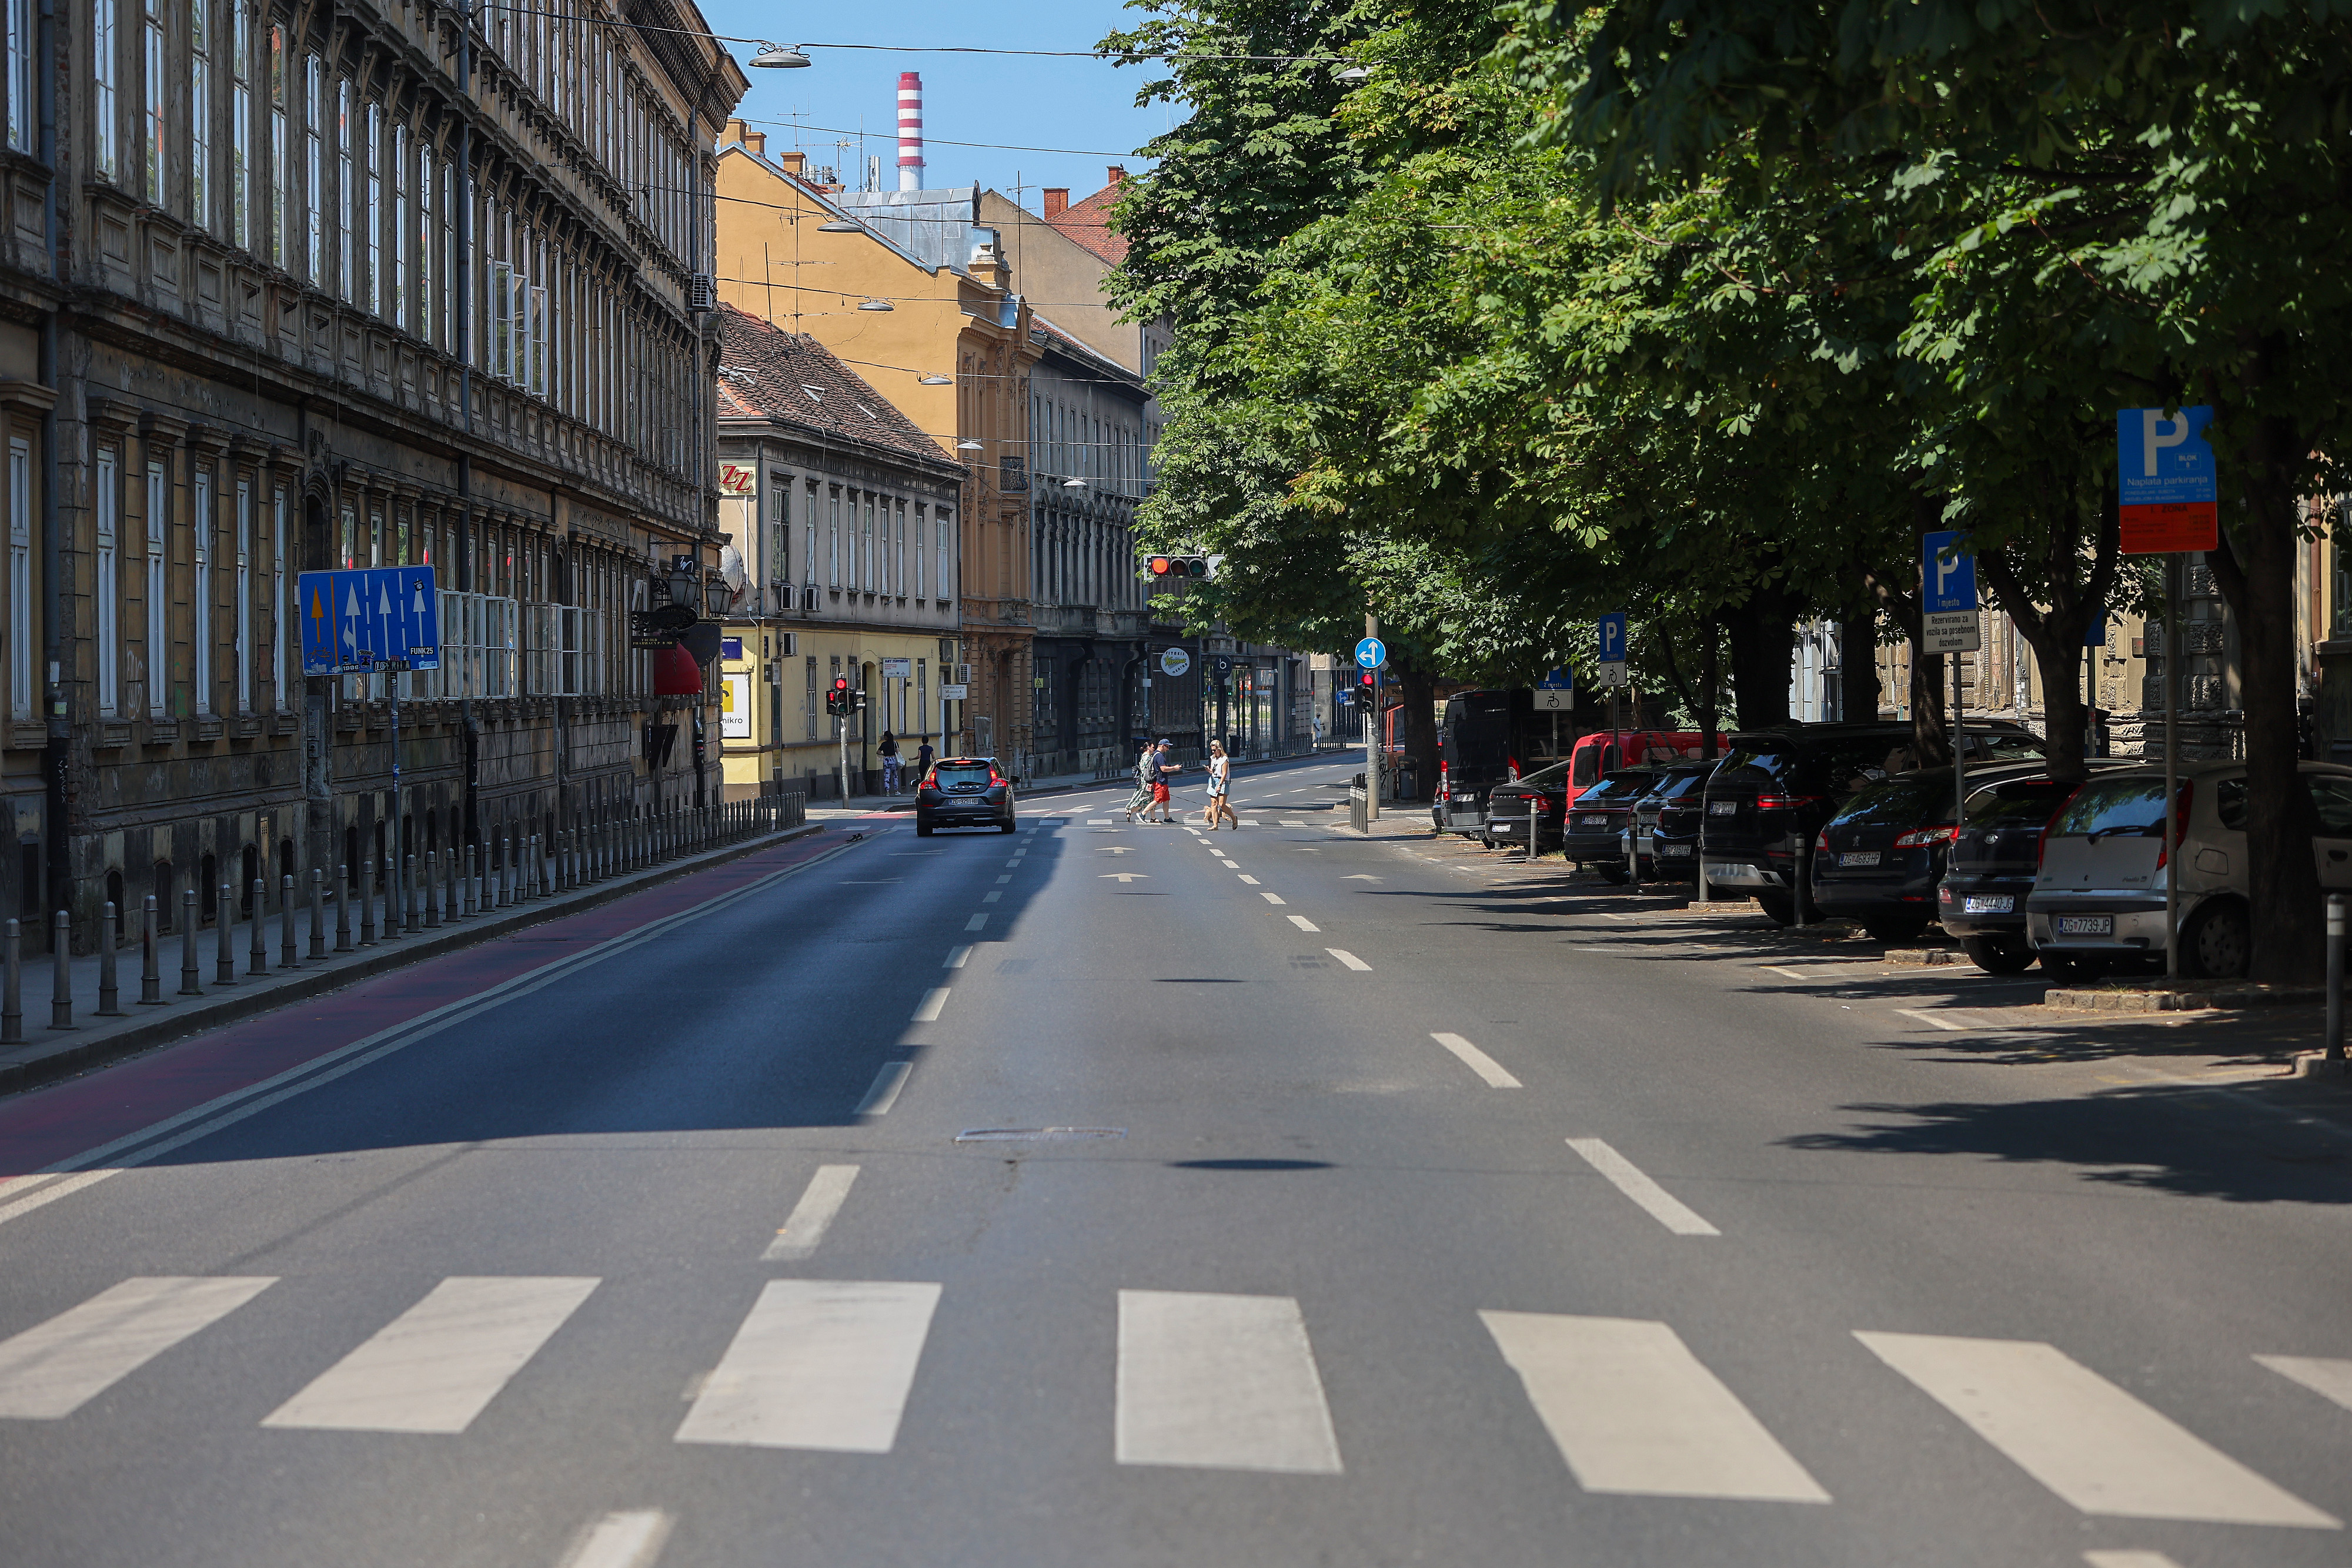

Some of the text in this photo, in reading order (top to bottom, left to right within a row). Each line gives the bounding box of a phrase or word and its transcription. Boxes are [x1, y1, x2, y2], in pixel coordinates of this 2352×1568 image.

[2143, 409, 2189, 476] P
[2127, 475, 2209, 487] Naplata parkiranja
[2161, 504, 2188, 513] ZONA
[1937, 547, 1958, 596] P
[1942, 598, 1960, 609] mjesto
[1931, 616, 1960, 625] Rezervirano
[1606, 621, 1617, 652] P
[1926, 626, 1940, 637] vozila
[1949, 625, 1976, 637] posebnom
[1939, 638, 1963, 647] dozvolom
[1172, 663, 1188, 674] CENTAR
[1712, 803, 1719, 813] ZG
[1843, 853, 1880, 864] ZG 4683-HP
[1971, 897, 2013, 909] ZG 4440-JG
[2063, 919, 2110, 932] ZG 7739-JP
